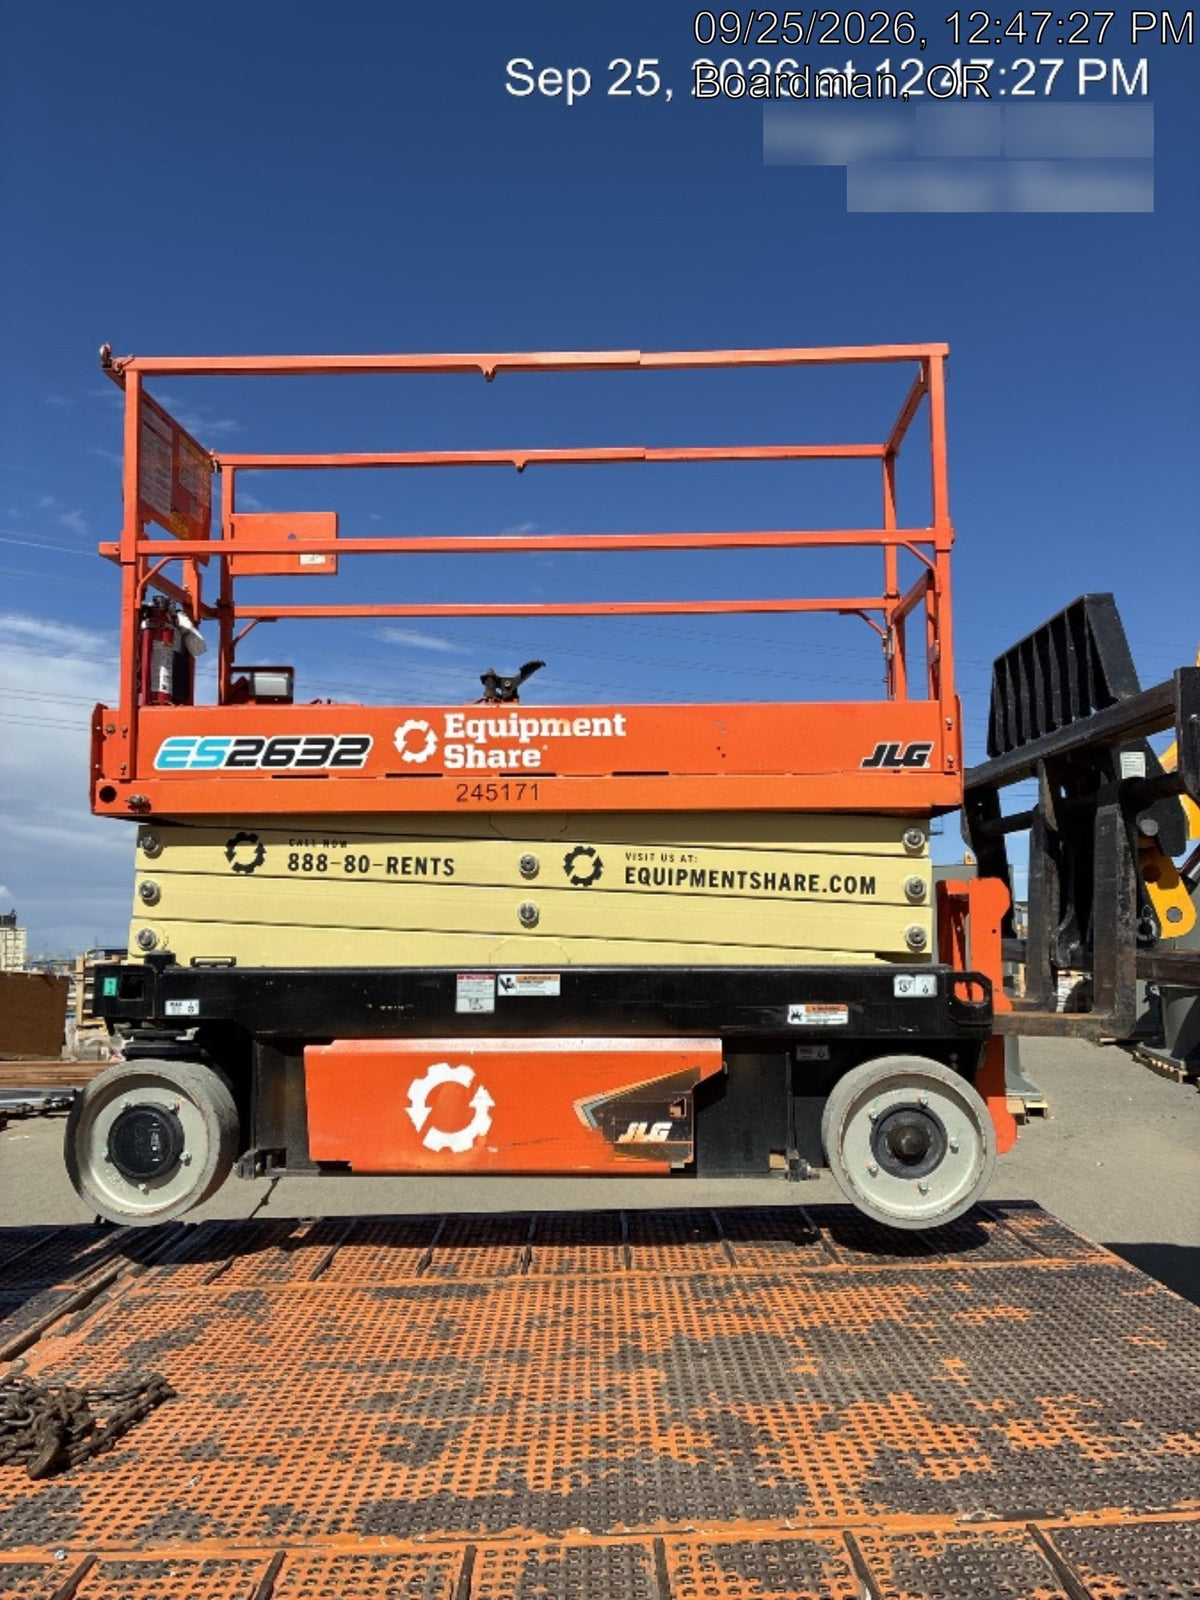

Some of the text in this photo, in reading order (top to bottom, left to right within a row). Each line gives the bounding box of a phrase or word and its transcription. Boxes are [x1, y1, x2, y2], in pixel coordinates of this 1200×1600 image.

[444, 713, 626, 743] Equipment
[154, 735, 373, 770] ES2632
[444, 744, 541, 768] Share
[860, 742, 934, 768] JLG
[456, 783, 539, 802] 245171
[289, 839, 348, 849] CALL NOW
[288, 853, 454, 877] 888-80-RENTS
[625, 852, 698, 863] VISIT US AT:
[625, 866, 876, 895] EQUIPMENTSHARE.COM
[618, 1121, 673, 1142] JLG
